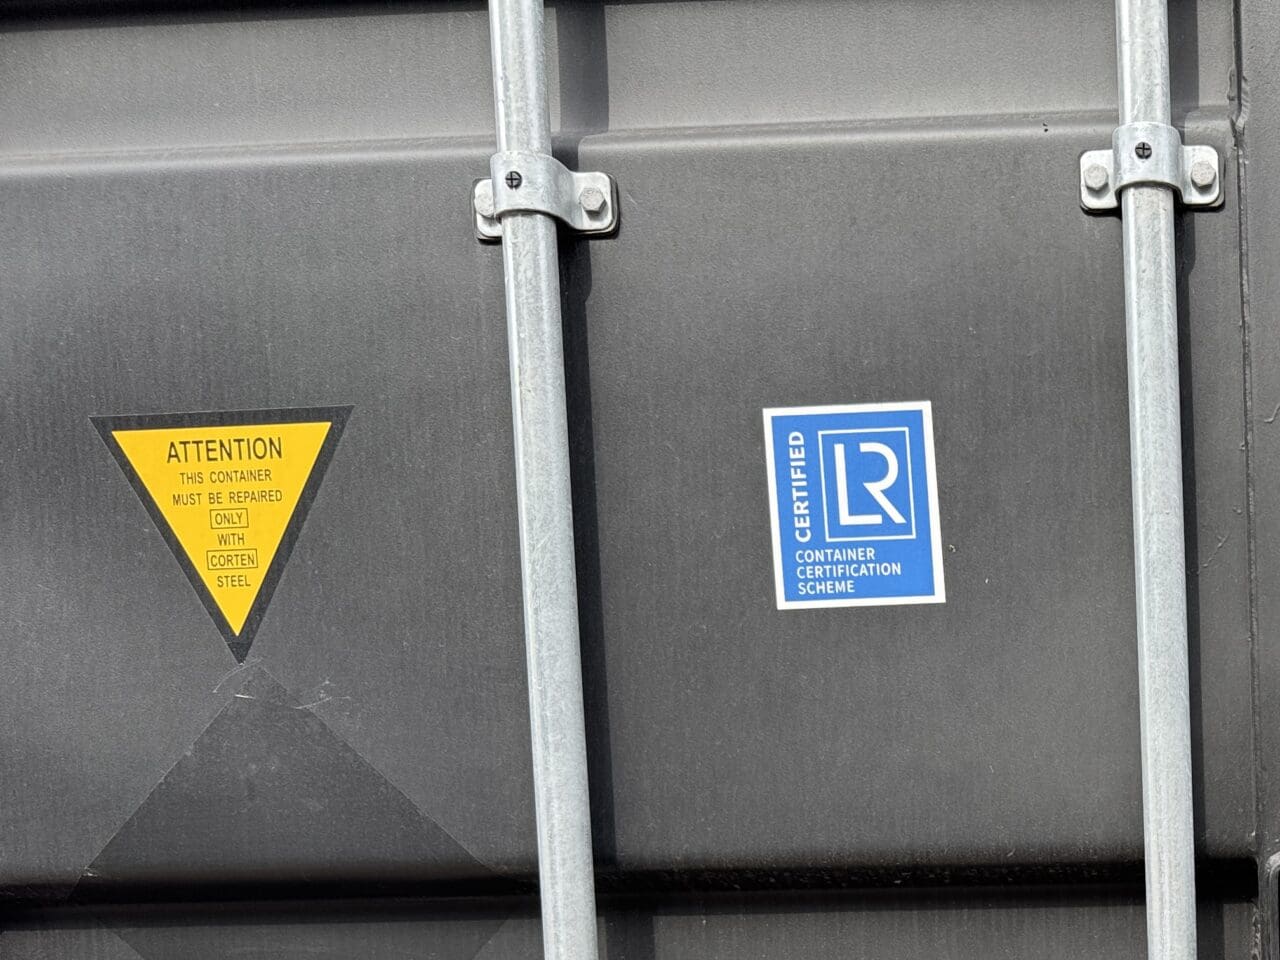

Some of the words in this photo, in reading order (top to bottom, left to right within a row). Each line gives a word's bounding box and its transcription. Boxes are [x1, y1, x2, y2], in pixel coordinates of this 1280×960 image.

[167, 437, 283, 463] ATTENTION
[180, 470, 204, 485] THIS
[209, 468, 273, 484] CONTAINER
[833, 441, 907, 526] LR
[788, 430, 812, 543] CERTIFIED
[172, 492, 203, 505] MUST
[208, 491, 223, 505] BE
[228, 489, 283, 504] REPAIRED
[214, 512, 243, 525] ONLY
[217, 533, 245, 546] WITH
[210, 554, 255, 567] CORTEN
[795, 547, 876, 563] CONTAINER
[796, 562, 902, 579] CERTIFICATION
[216, 574, 252, 588] STEEL
[798, 580, 855, 595] SCHEME
